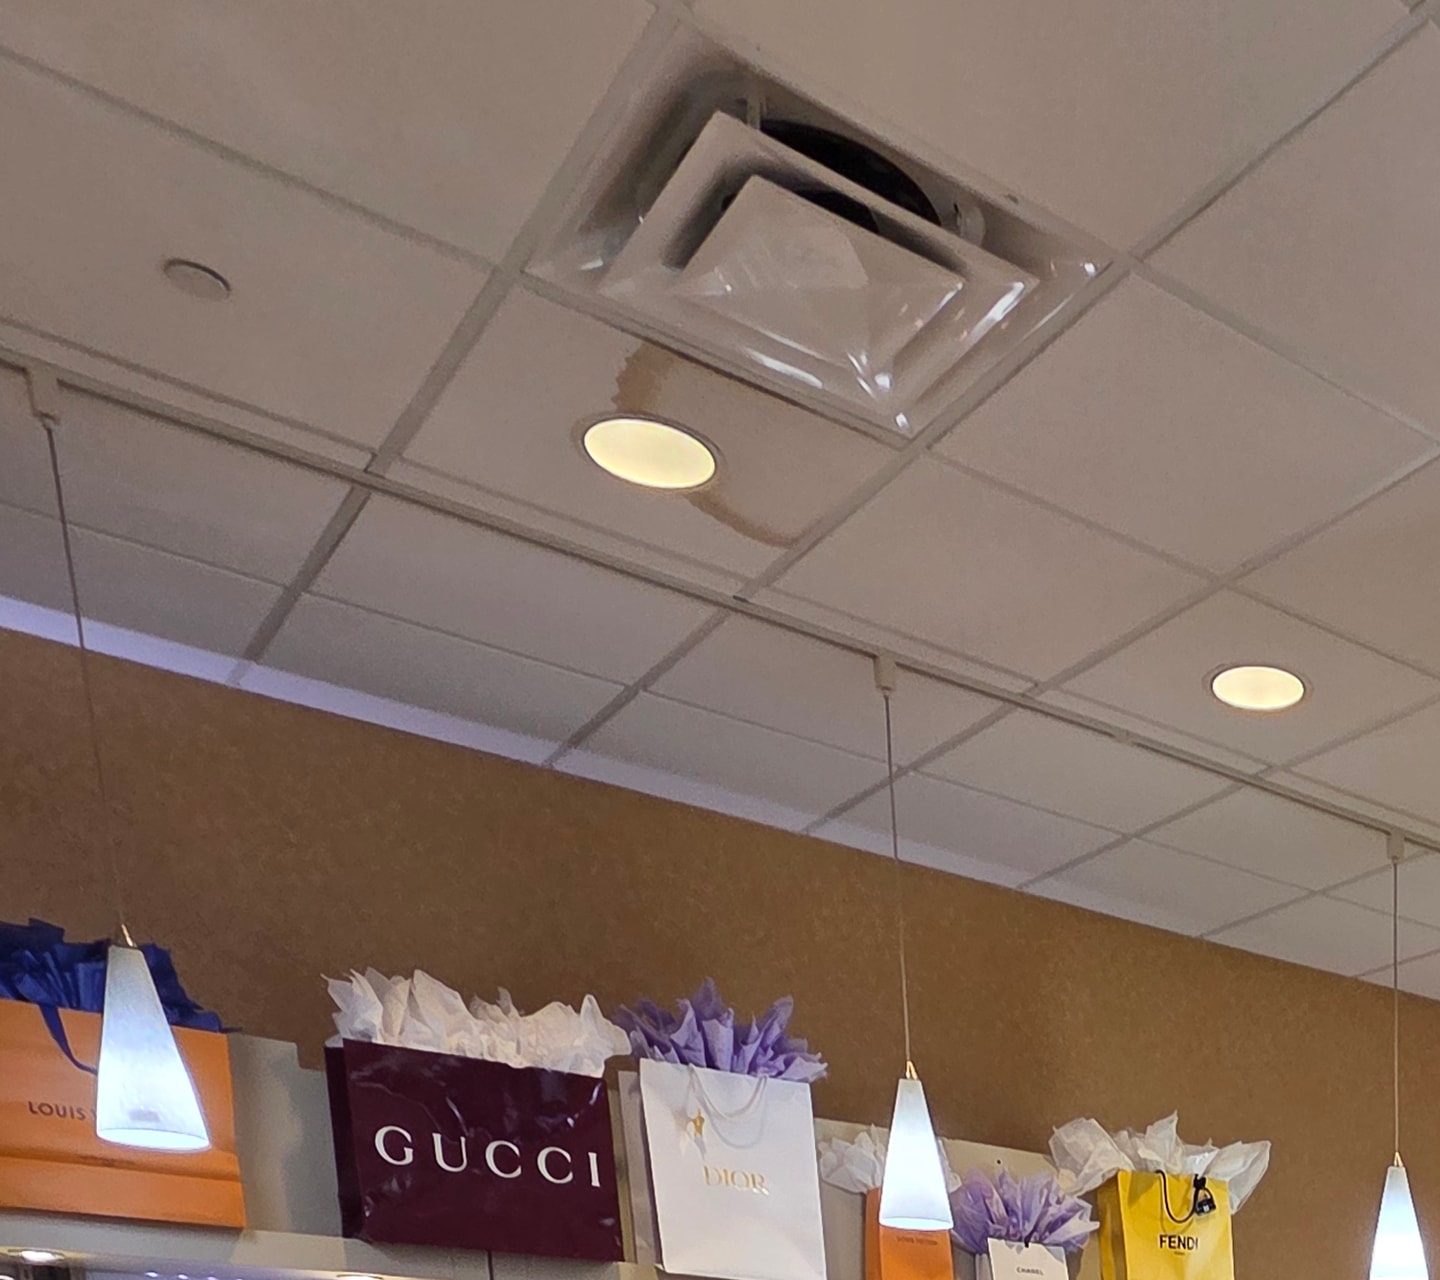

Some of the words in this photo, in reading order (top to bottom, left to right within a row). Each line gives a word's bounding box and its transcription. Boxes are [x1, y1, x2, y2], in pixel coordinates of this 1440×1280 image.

[28, 1101, 86, 1121] LOUIS
[374, 1125, 601, 1188] GUCCI
[704, 1165, 769, 1195] DIOR
[1159, 1234, 1199, 1250] FENDI
